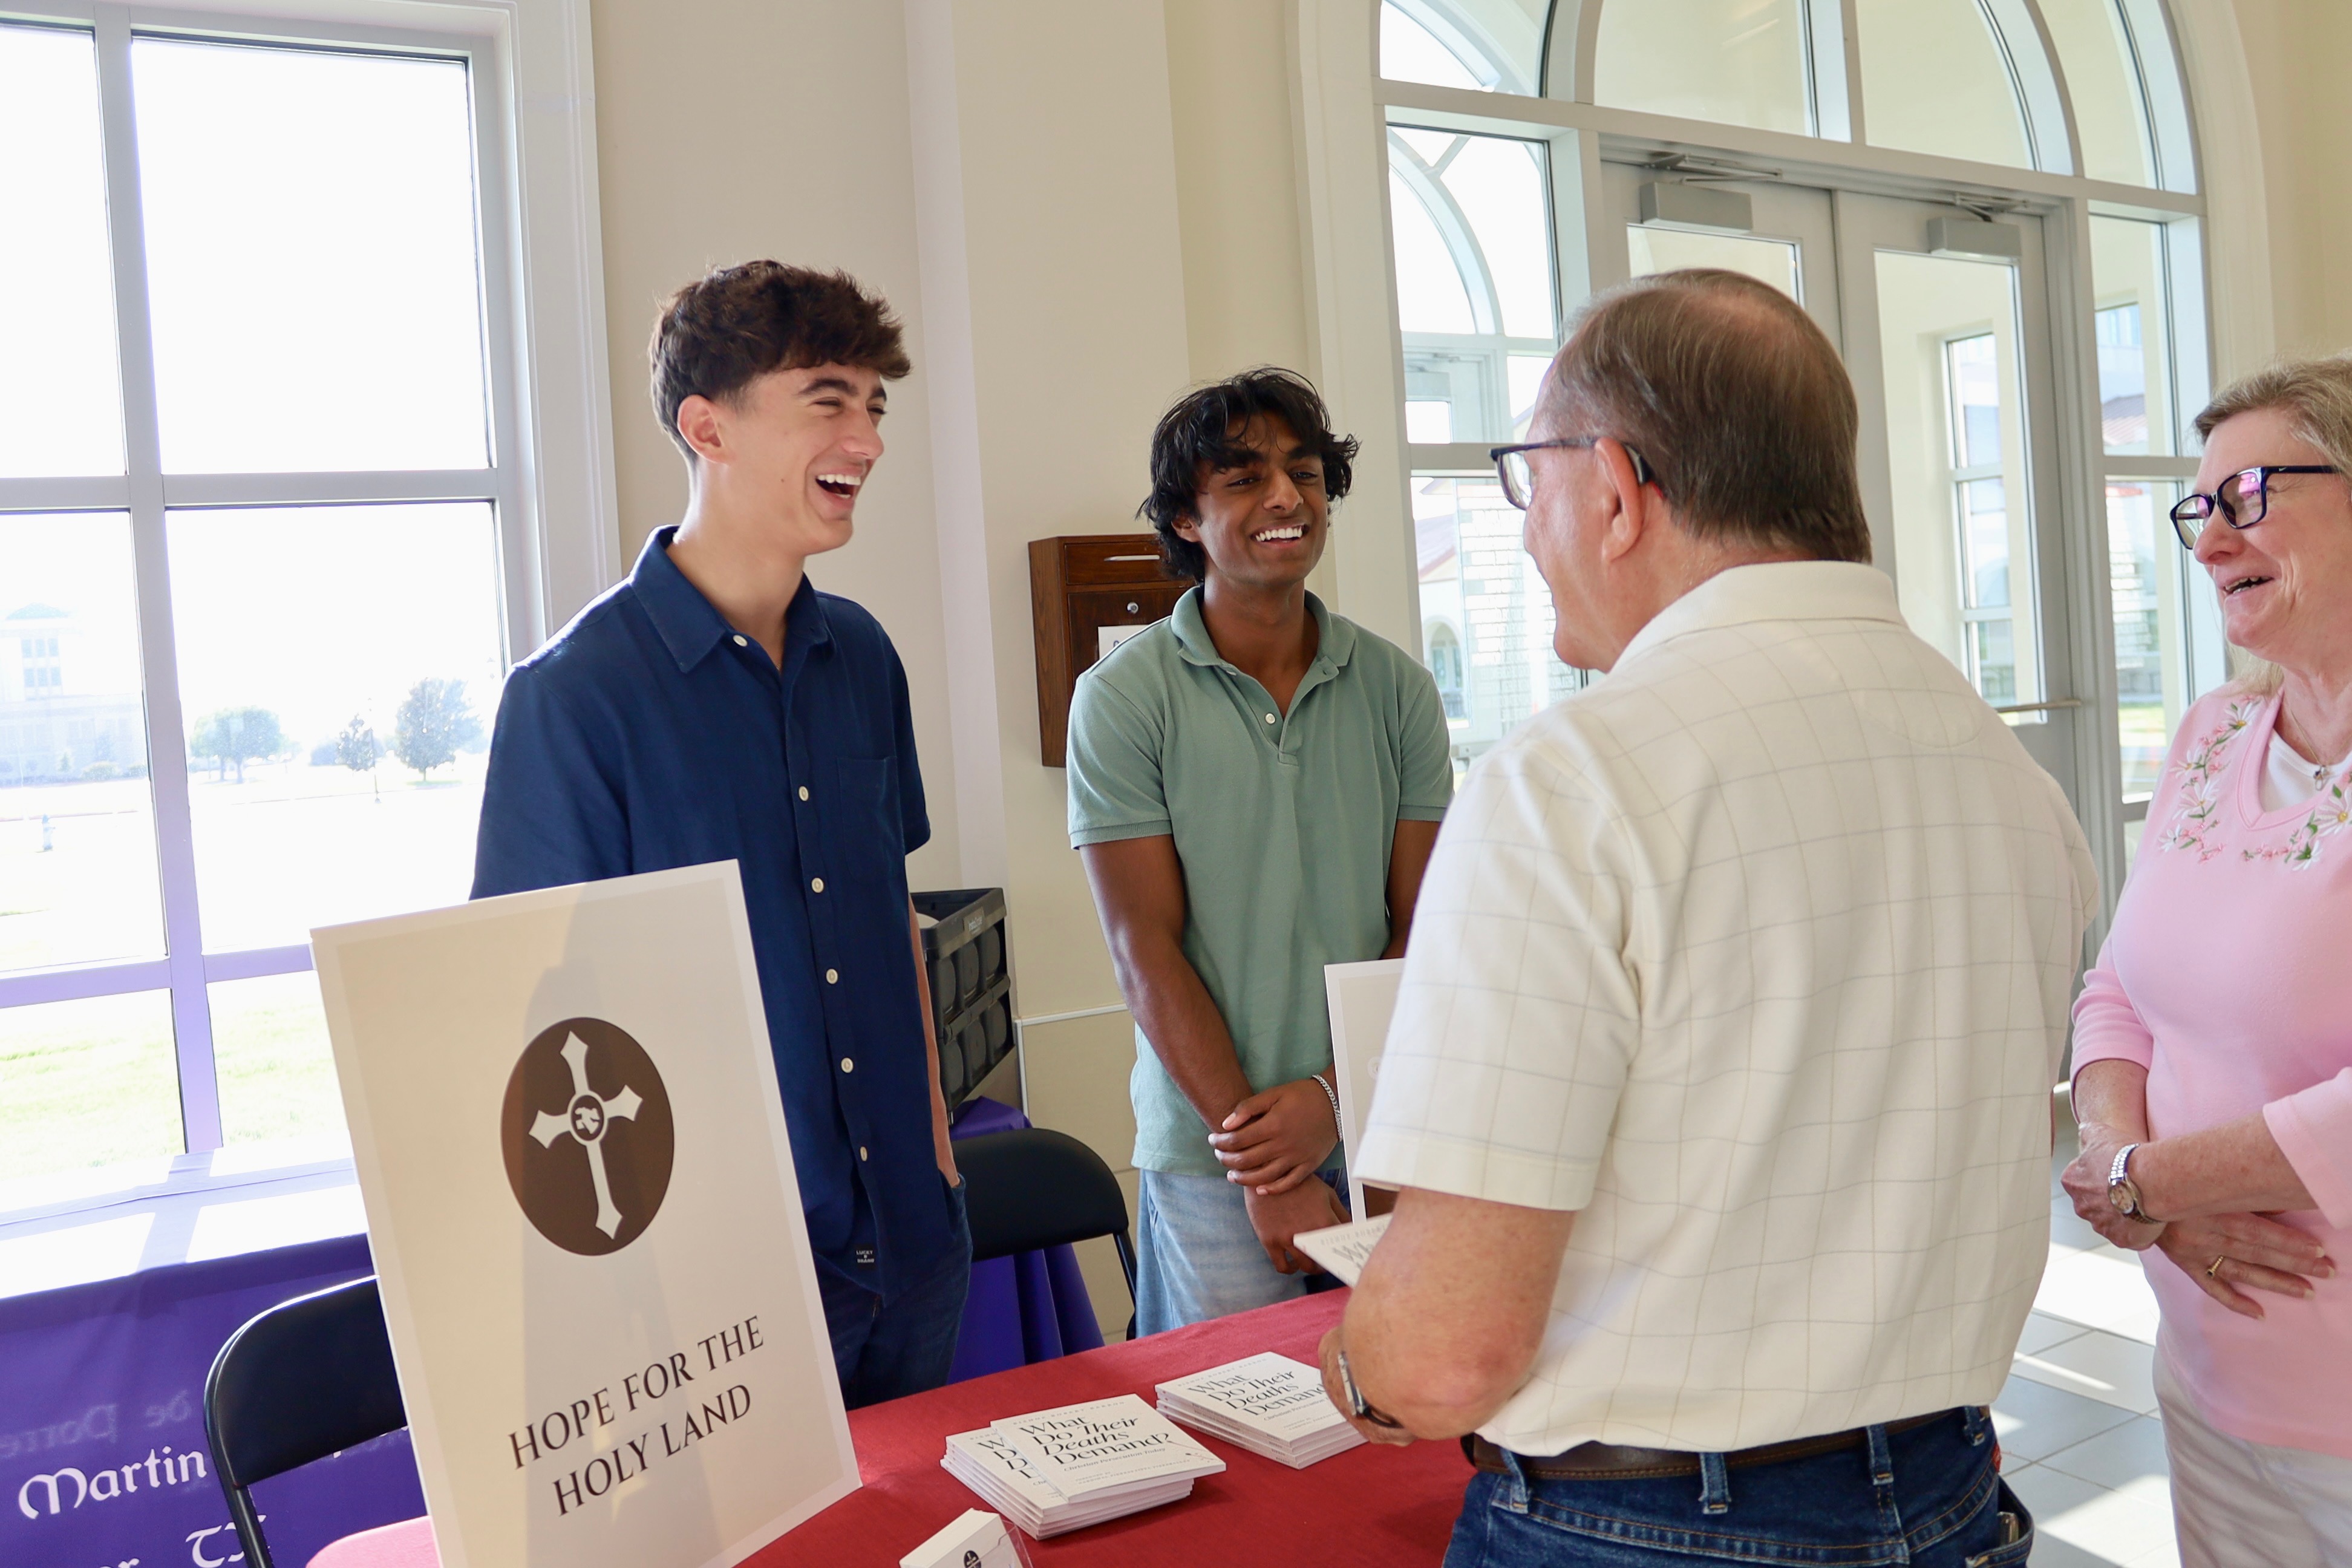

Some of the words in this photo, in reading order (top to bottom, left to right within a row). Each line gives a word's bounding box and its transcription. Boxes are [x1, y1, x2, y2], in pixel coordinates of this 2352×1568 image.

[508, 1388, 615, 1470] HOPE
[622, 1353, 694, 1411] FOR
[697, 1315, 763, 1371] THE
[1187, 1374, 1251, 1394] What
[1207, 1388, 1245, 1401] Do
[1243, 1371, 1295, 1390] Their
[1226, 1382, 1299, 1409] Deaths
[1019, 1417, 1089, 1434] What
[1032, 1431, 1073, 1445] Do
[1077, 1418, 1138, 1435] Their
[552, 1433, 649, 1516] HOLY
[660, 1385, 751, 1457] LAND
[1043, 1431, 1129, 1455] Deaths
[1053, 1432, 1169, 1465] Demand?
[19, 1446, 207, 1519] Martin
